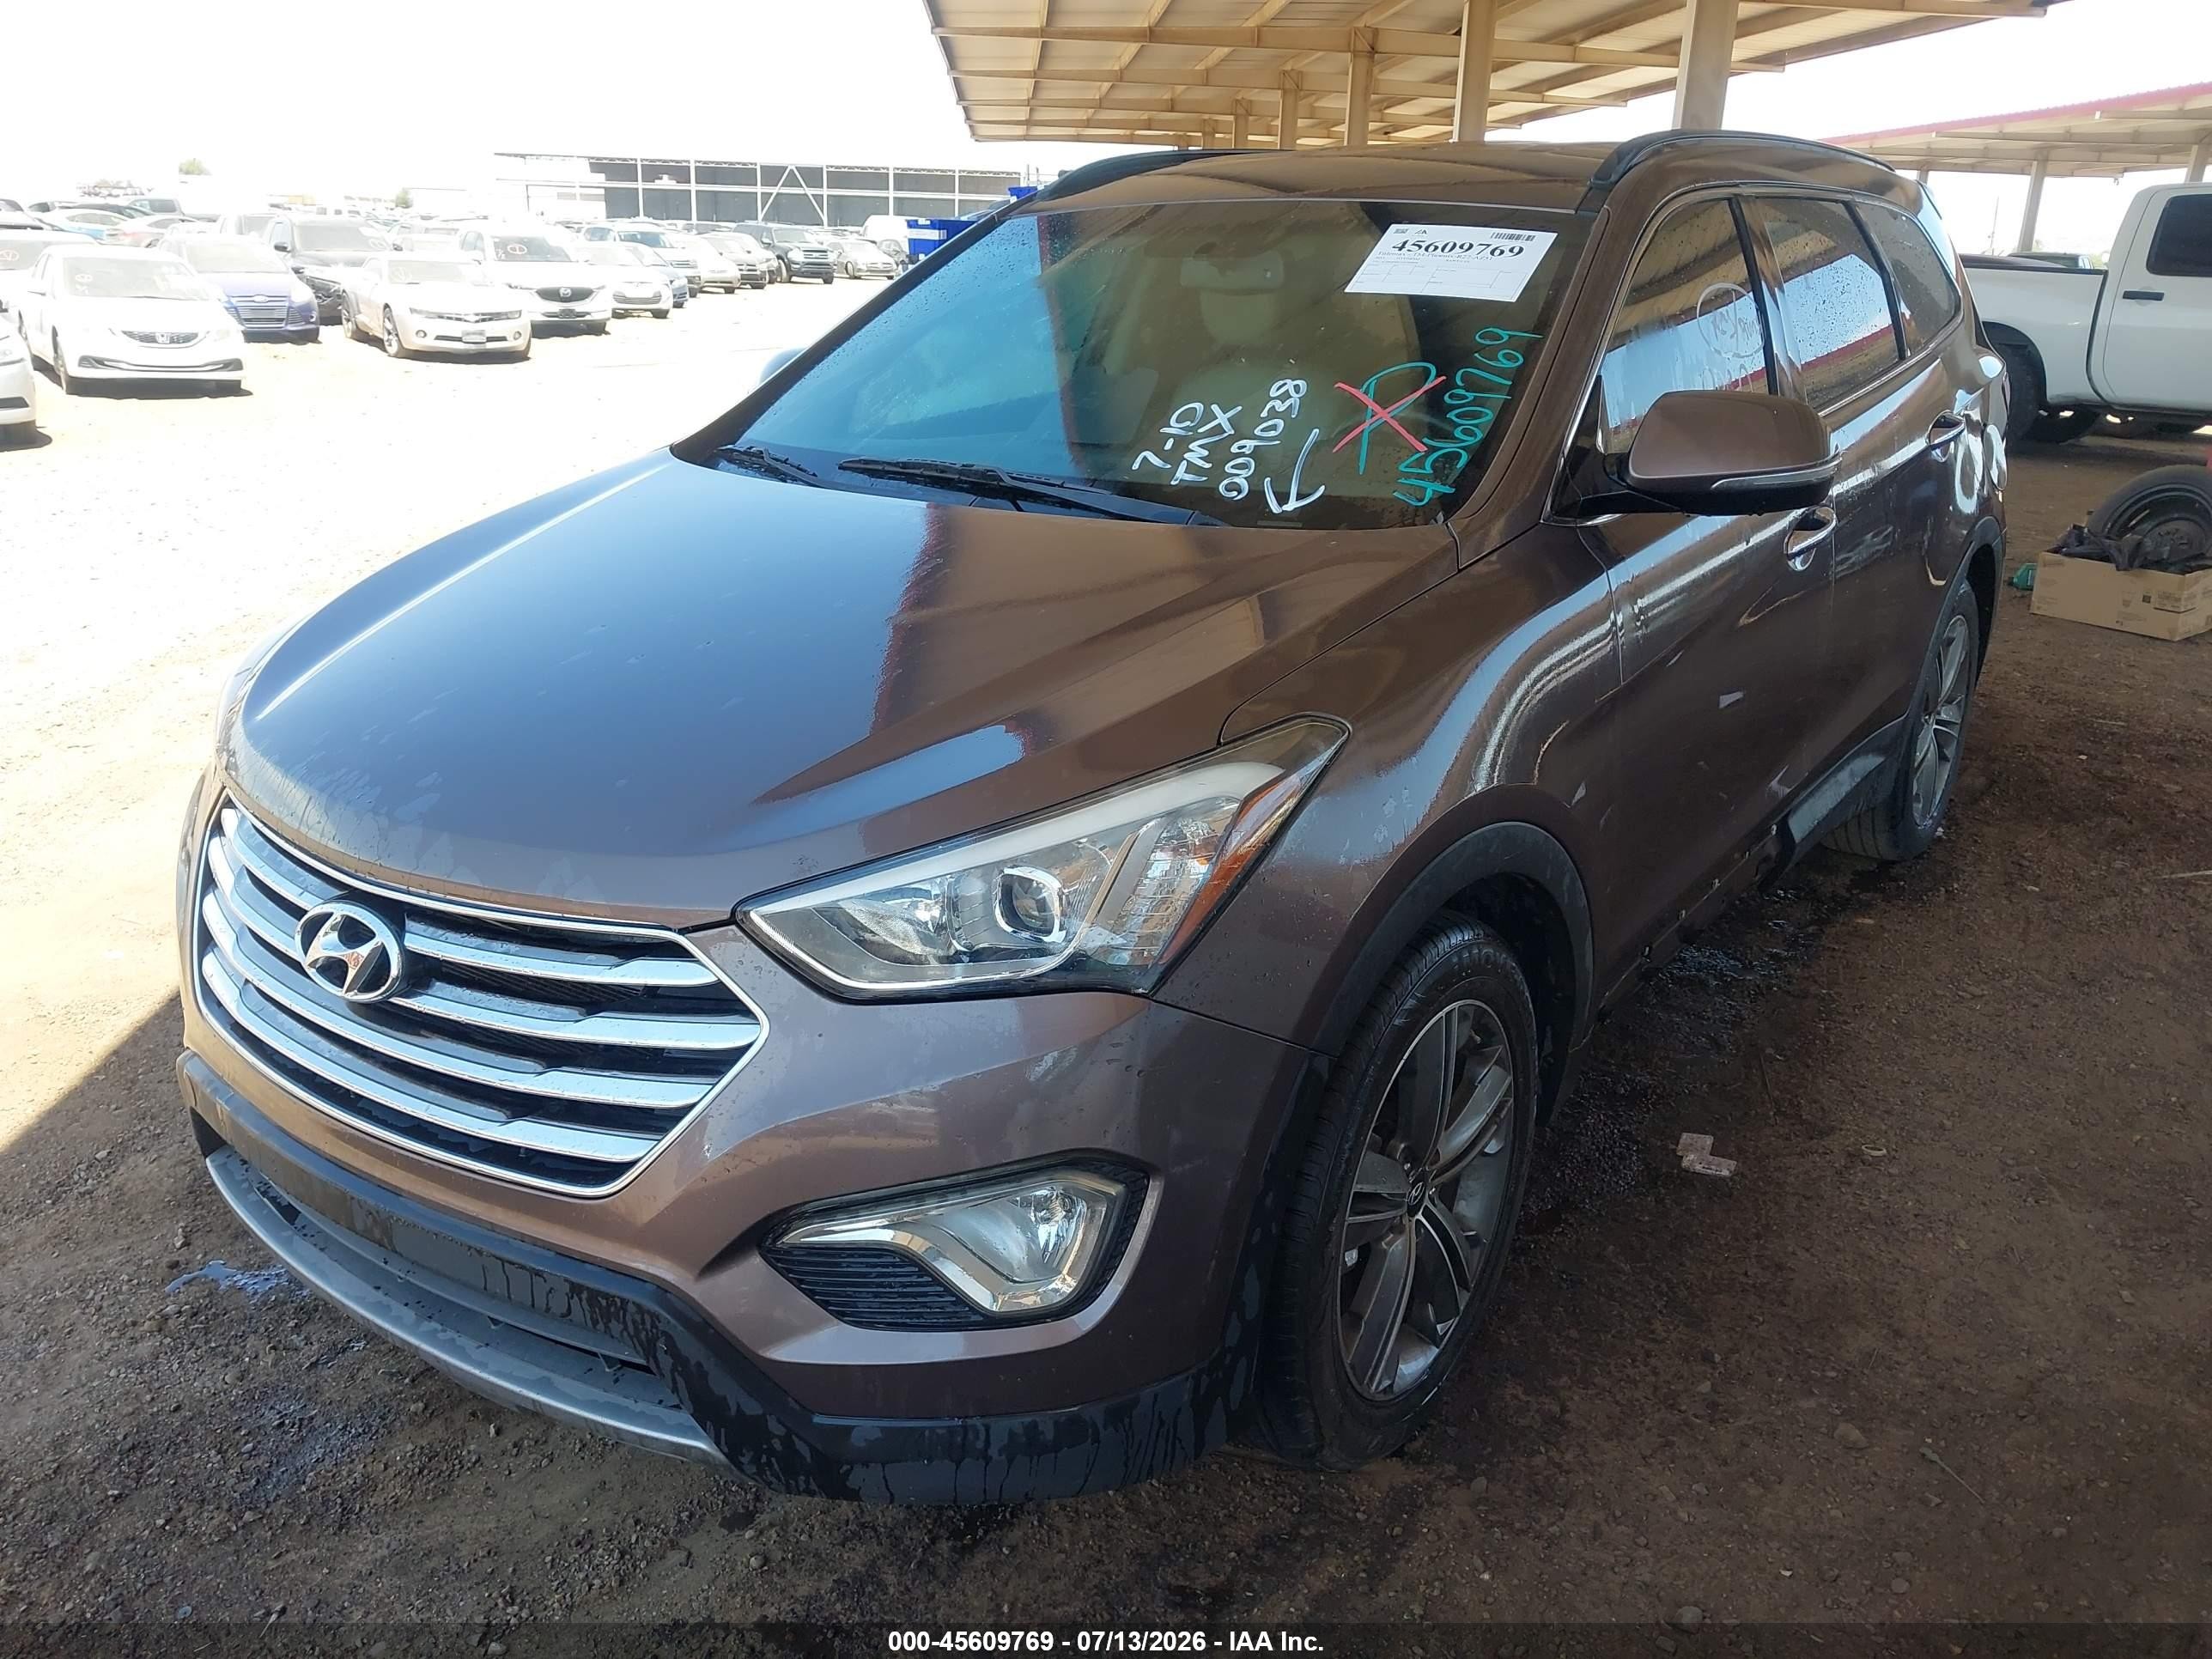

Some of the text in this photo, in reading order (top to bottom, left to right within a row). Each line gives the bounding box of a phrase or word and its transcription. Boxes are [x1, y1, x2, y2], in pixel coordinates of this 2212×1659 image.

[1391, 240, 1525, 258] 45609769
[1131, 401, 1205, 471] 7-10
[1170, 403, 1243, 486] TMX
[1218, 378, 1309, 501] 009038
[1392, 326, 1545, 507] 45609769
